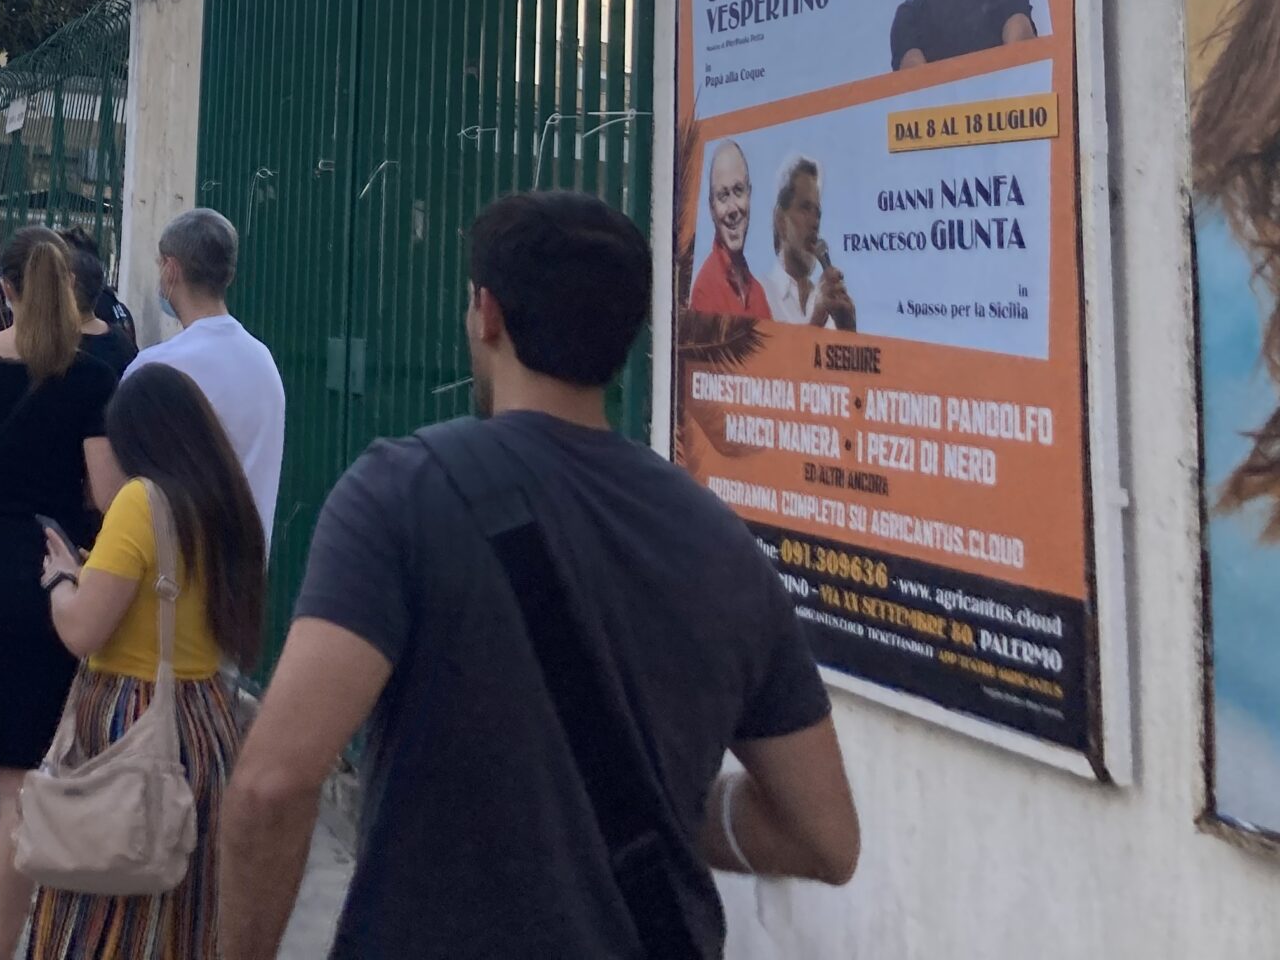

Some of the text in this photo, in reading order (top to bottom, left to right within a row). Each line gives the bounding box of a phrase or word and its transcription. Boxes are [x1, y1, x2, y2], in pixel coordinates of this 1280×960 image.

[740, 67, 766, 82] Coque
[894, 105, 1048, 141] DAL 8 AL 18 LUGLIO
[877, 174, 1025, 212] GIANNI NANFA
[842, 217, 1027, 252] FRANCESCO GIUNTA
[1018, 283, 1029, 298] in
[896, 299, 1029, 320] A Spasso per la Sicilia
[813, 344, 882, 375] A SEGUIRE
[692, 370, 1054, 446] ERNESTOMARIA PONTE ANTONIO PANDOLFO
[725, 413, 997, 486] MARCO MANERA I PEZZI DI NERO
[804, 461, 890, 497] ED ALTRI ANCORA
[781, 488, 846, 528] COMPLETO
[849, 500, 868, 533] SU
[871, 507, 1025, 569] AGRICANTUS.CLOUD
[780, 537, 889, 589] 091.309636
[980, 628, 1064, 673] PALERMO
